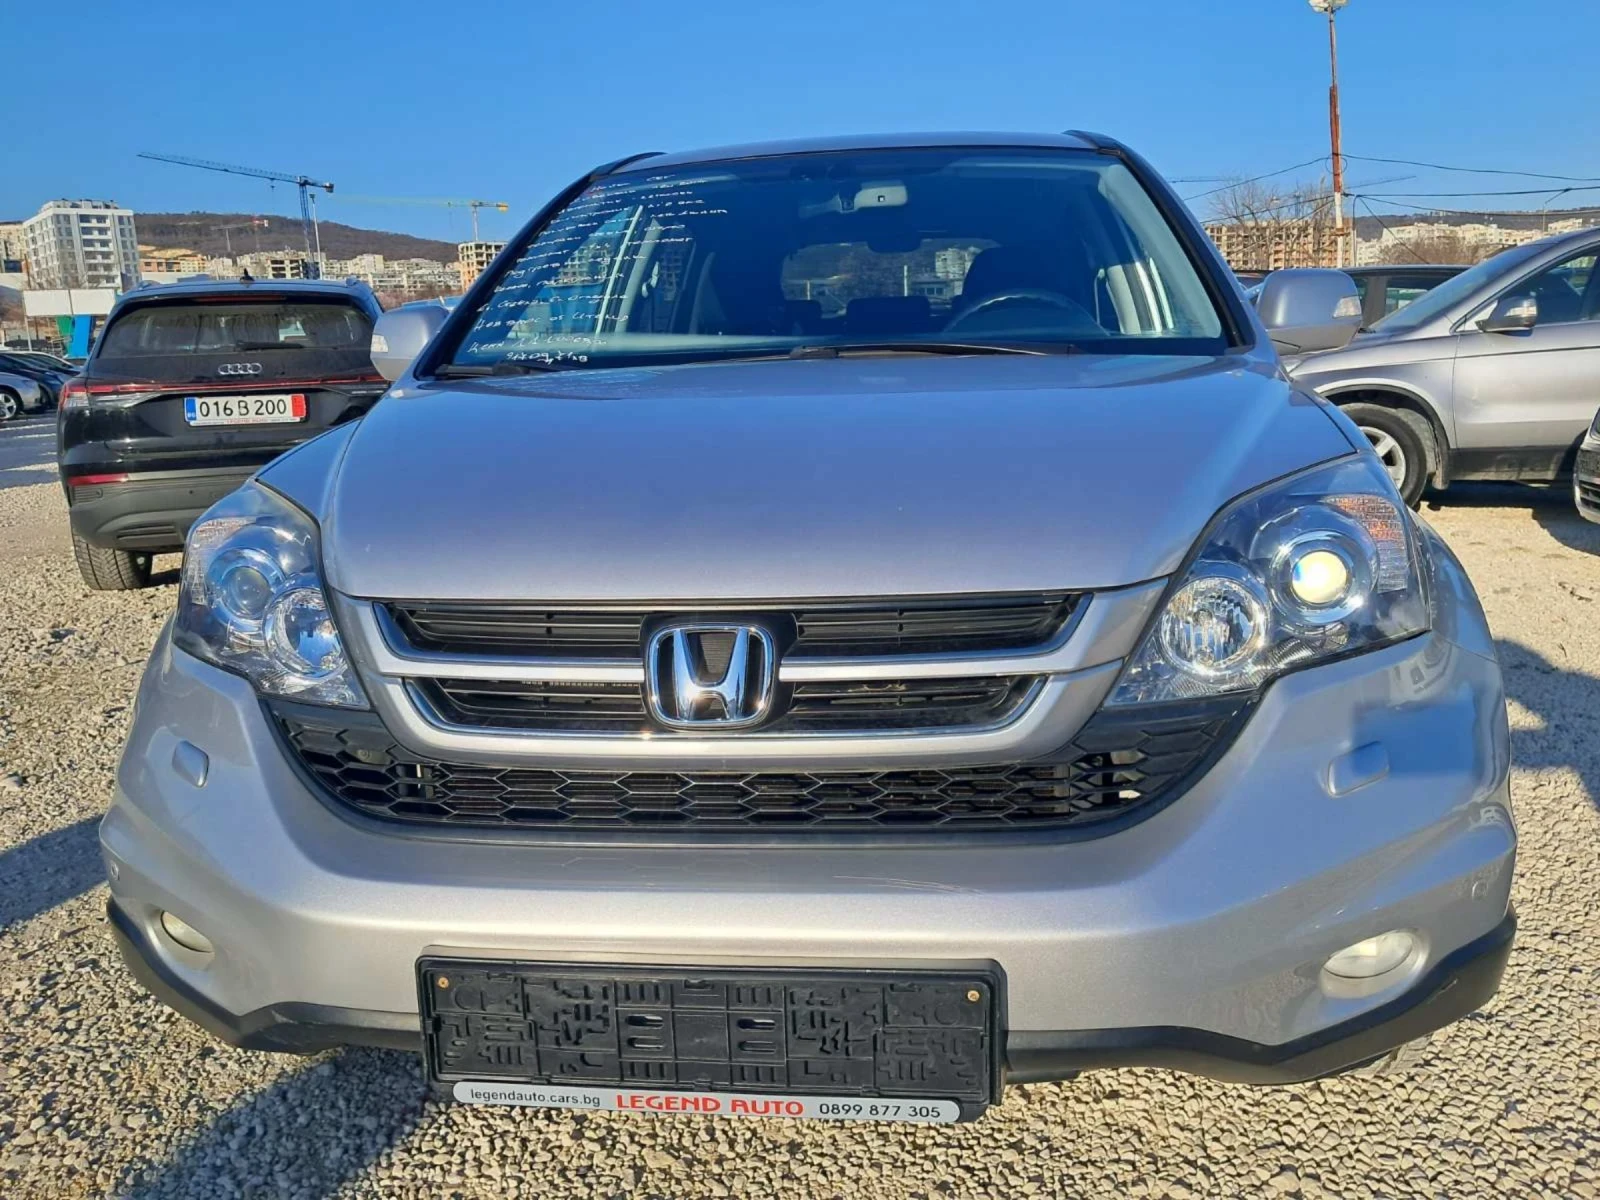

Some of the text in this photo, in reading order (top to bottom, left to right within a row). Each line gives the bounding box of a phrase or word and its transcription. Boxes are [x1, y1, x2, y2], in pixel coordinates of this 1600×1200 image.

[200, 399, 286, 417] 016 B 200
[471, 1088, 941, 1118] legendauto.cars.bg LEGEND AUTO 0899 877 305
